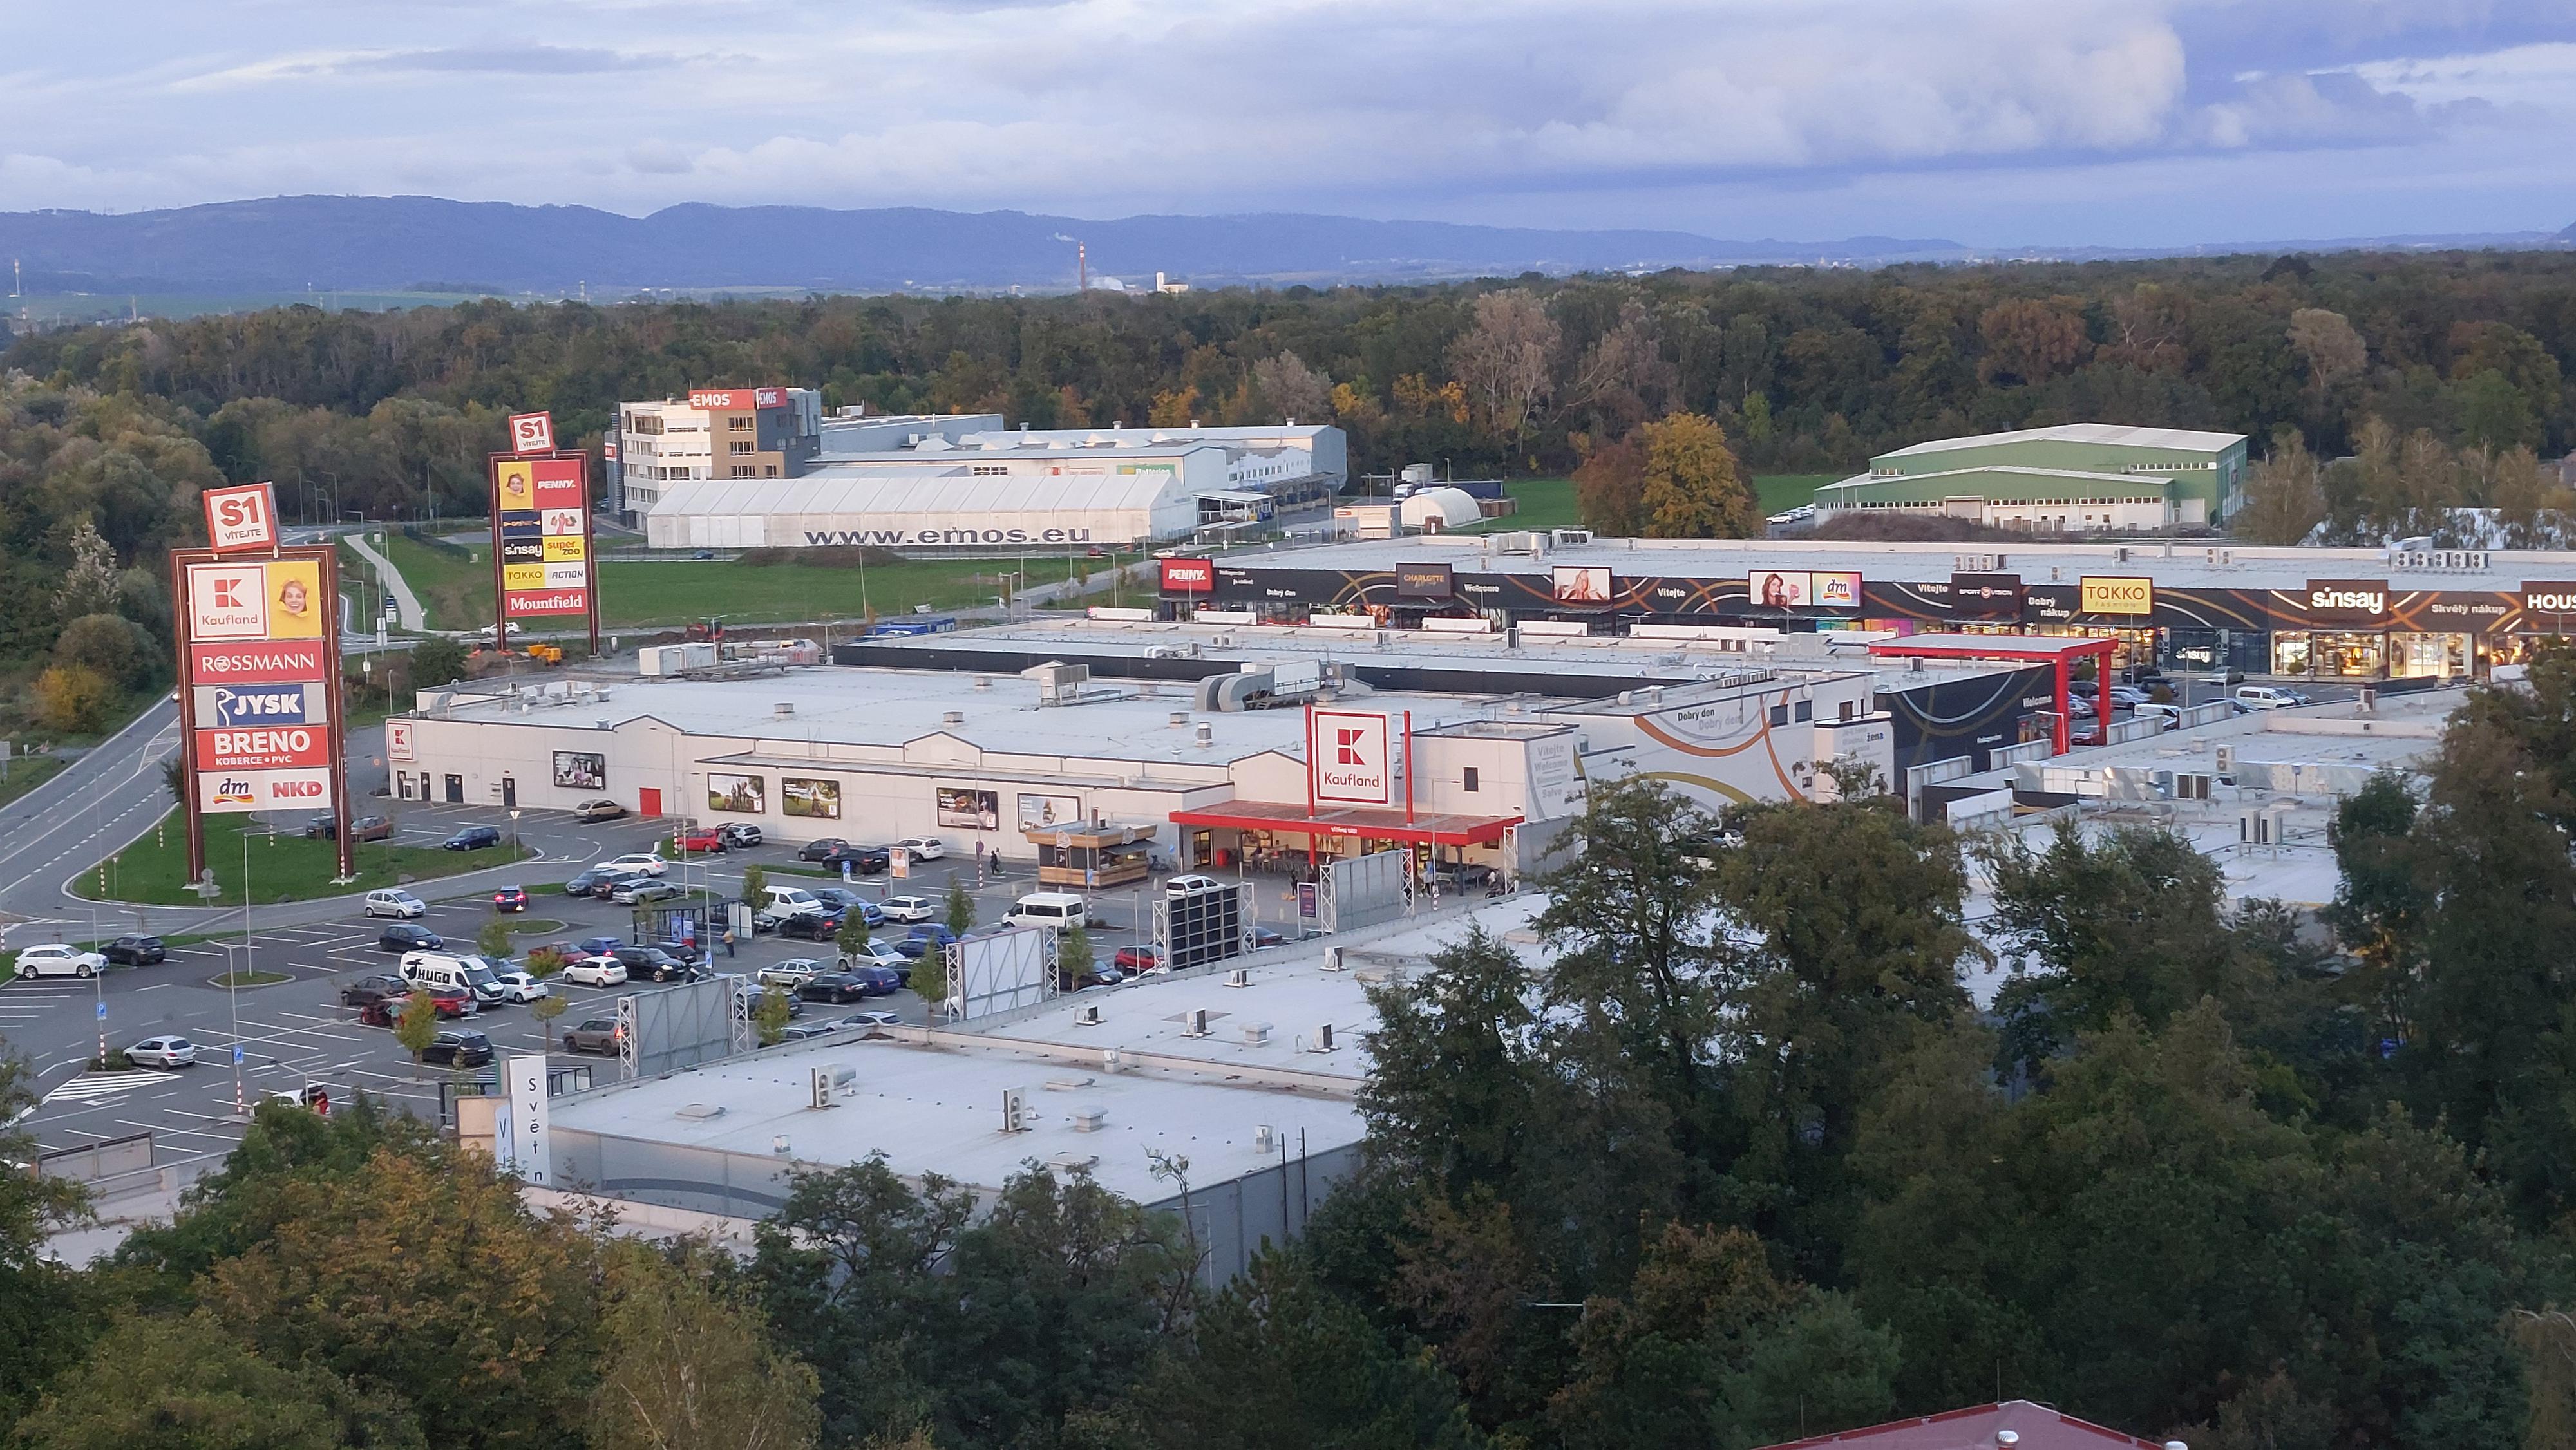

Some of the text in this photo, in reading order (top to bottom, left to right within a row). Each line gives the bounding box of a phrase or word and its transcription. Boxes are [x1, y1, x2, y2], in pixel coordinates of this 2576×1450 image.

[690, 393, 730, 406] EMOS
[759, 391, 777, 404] EMOS
[520, 420, 544, 439] S1
[220, 496, 260, 527] S1
[224, 527, 261, 540] VÍTEJTE
[804, 527, 1090, 545] www.emos.eu
[504, 543, 542, 557] sinsay
[547, 541, 575, 551] super
[552, 570, 583, 579] ACTION
[1827, 579, 1847, 594] dm
[511, 594, 582, 610] Mountfield
[2028, 597, 2055, 607] Dobrý
[2312, 587, 2383, 614] sinsay
[2040, 608, 2069, 619] nákup
[2432, 604, 2506, 615] Skvělý nákup
[202, 612, 258, 626] Kaufland
[202, 653, 315, 673] ROSSMANN
[234, 693, 301, 715] JYSK
[214, 730, 310, 755] BRENO
[215, 755, 292, 766] KOBERCE PVC
[218, 777, 249, 795] dm
[1325, 772, 1379, 787] Kaufland
[272, 781, 323, 798] NKD
